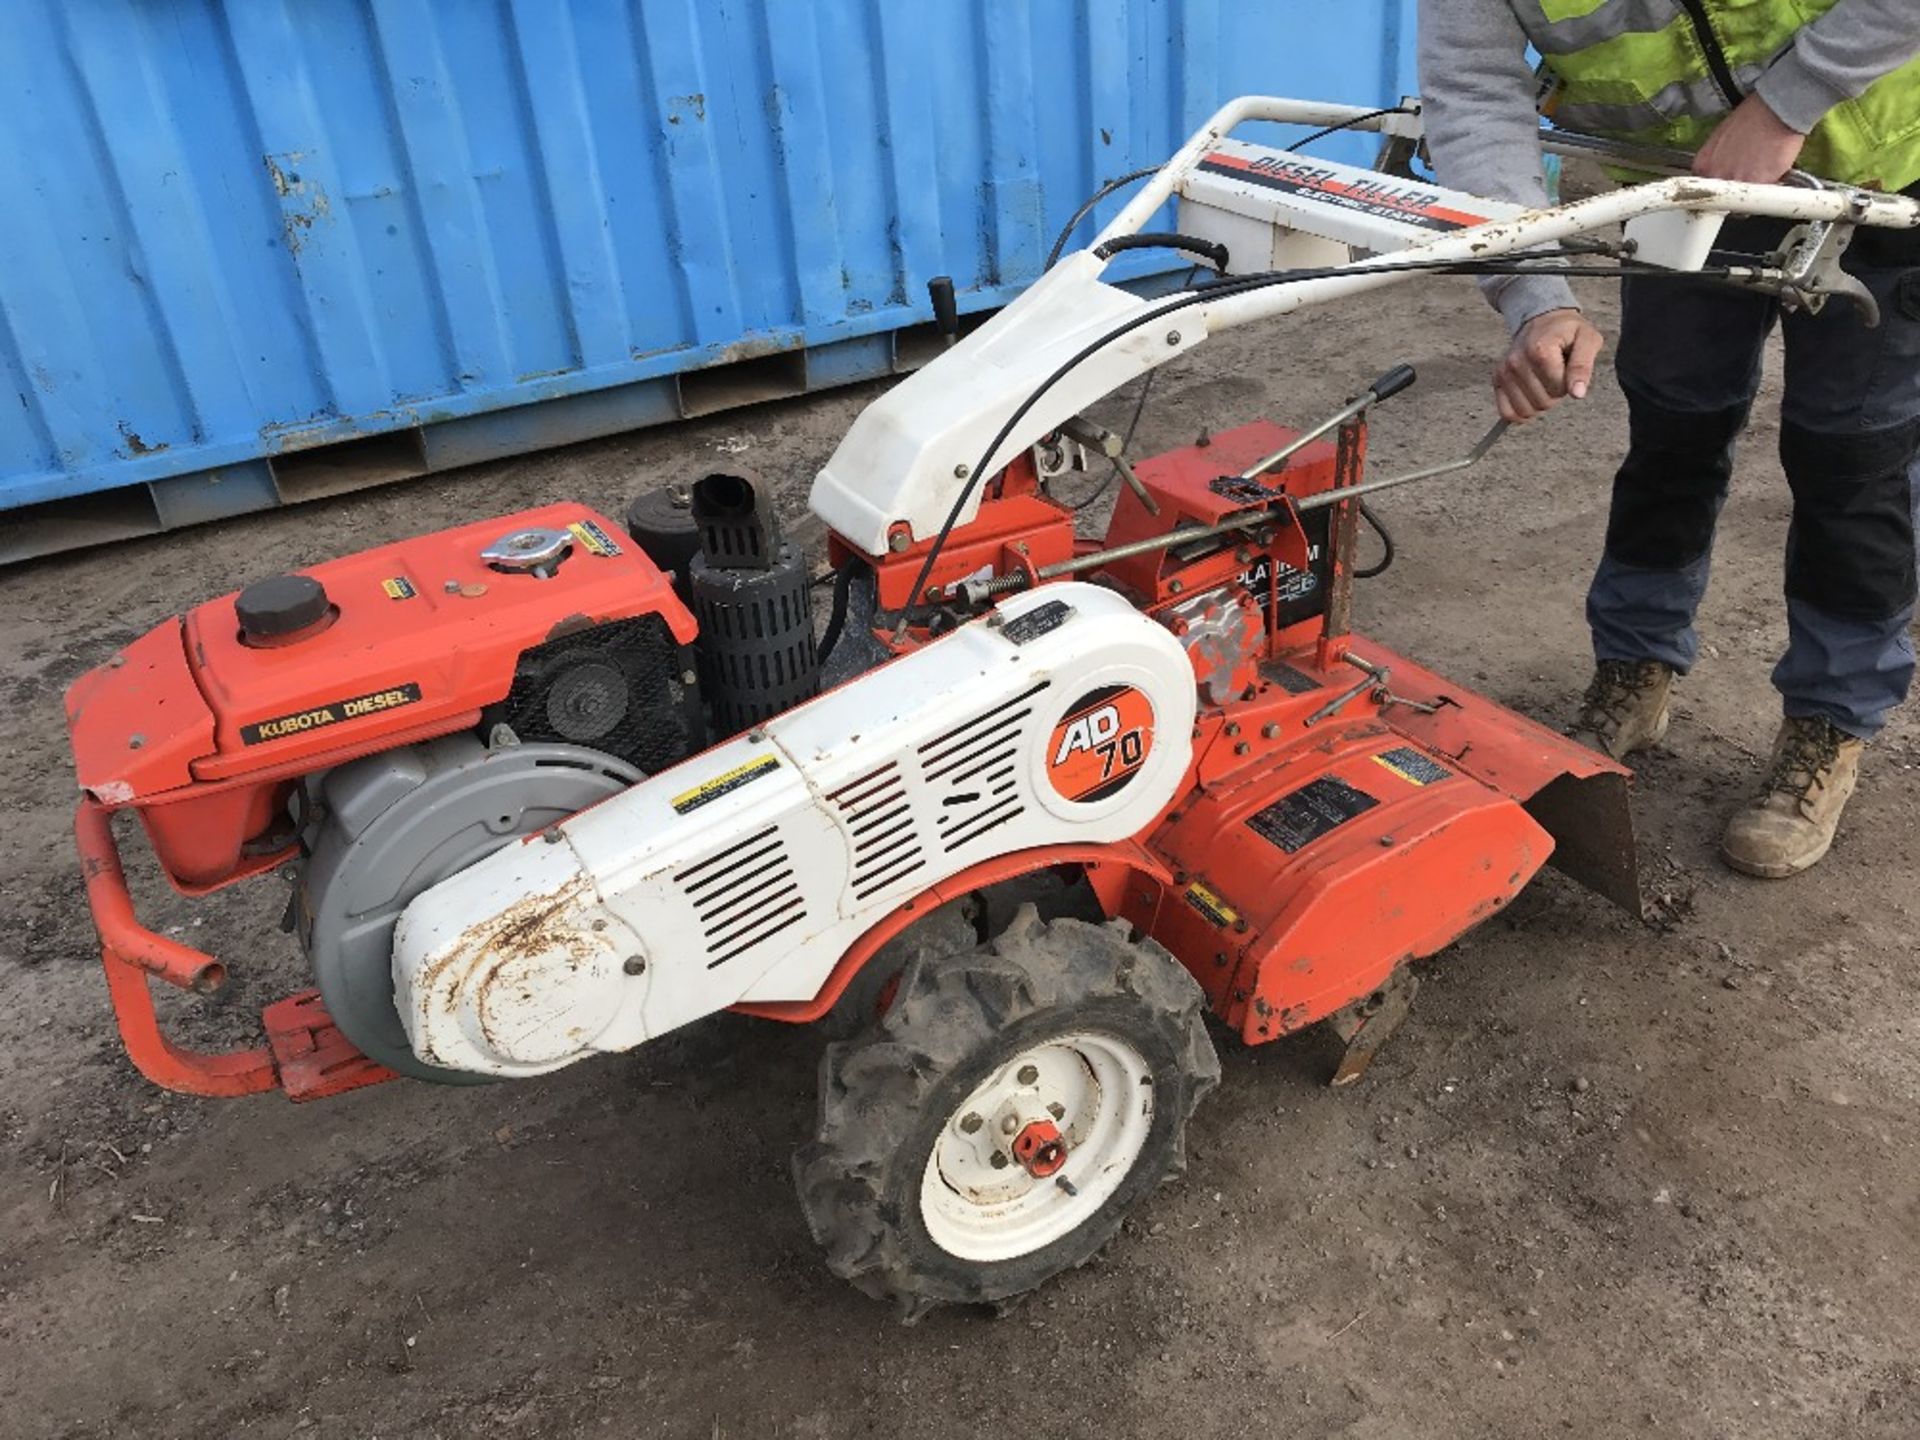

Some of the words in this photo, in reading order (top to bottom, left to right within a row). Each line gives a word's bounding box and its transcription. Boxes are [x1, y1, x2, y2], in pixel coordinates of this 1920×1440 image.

[1248, 156, 1338, 187] DIESEL
[1343, 178, 1440, 211] TILLER
[258, 709, 335, 739] KUBOTA
[343, 690, 410, 718] DIESEL
[1053, 705, 1121, 768] AD
[1095, 729, 1143, 778] 70
